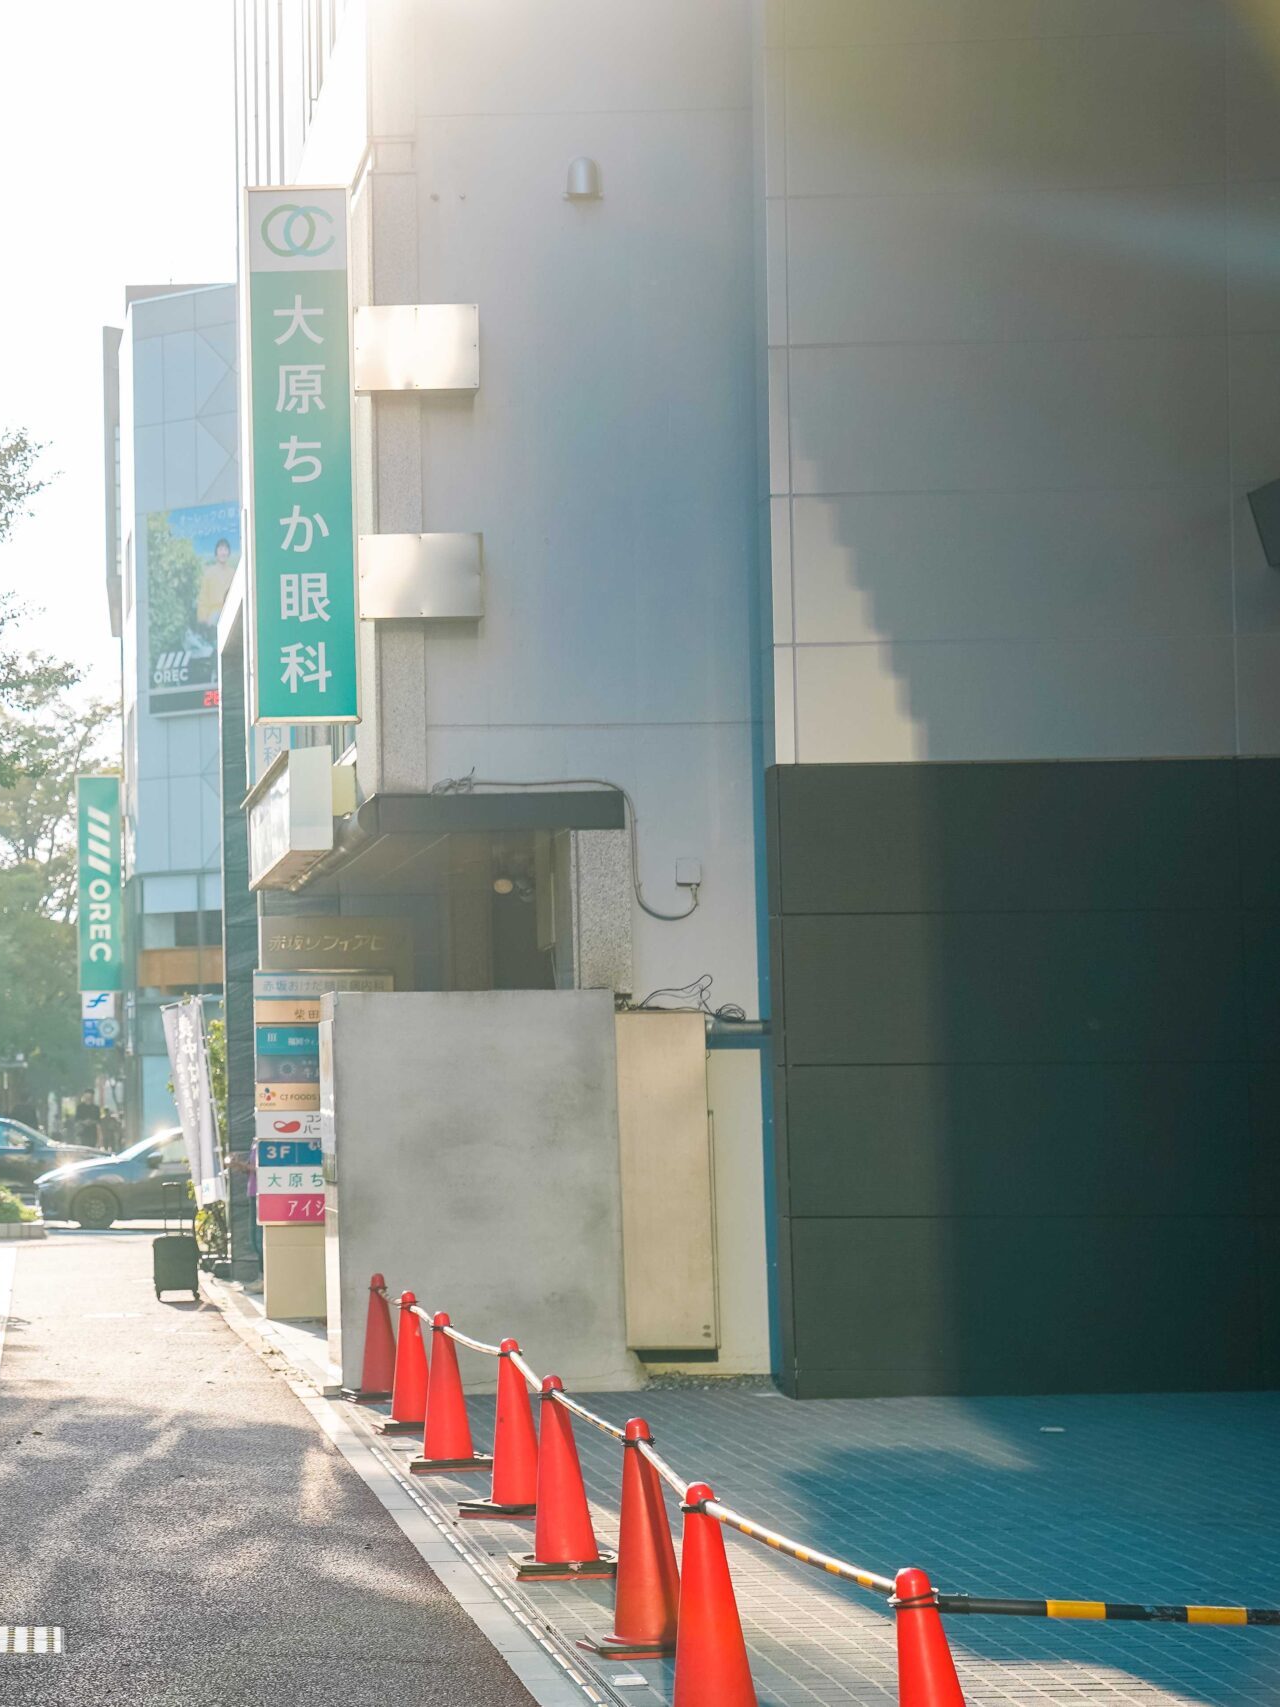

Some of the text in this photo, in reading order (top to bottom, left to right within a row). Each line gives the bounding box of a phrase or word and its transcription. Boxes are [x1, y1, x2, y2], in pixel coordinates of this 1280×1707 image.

[273, 294, 332, 694] 大原ちか眼科
[153, 668, 189, 684] OREC
[88, 878, 112, 963] OREC
[267, 1146, 291, 1159] 3F
[267, 1172, 324, 1188] 大原ち
[287, 1199, 326, 1217] アイシ
